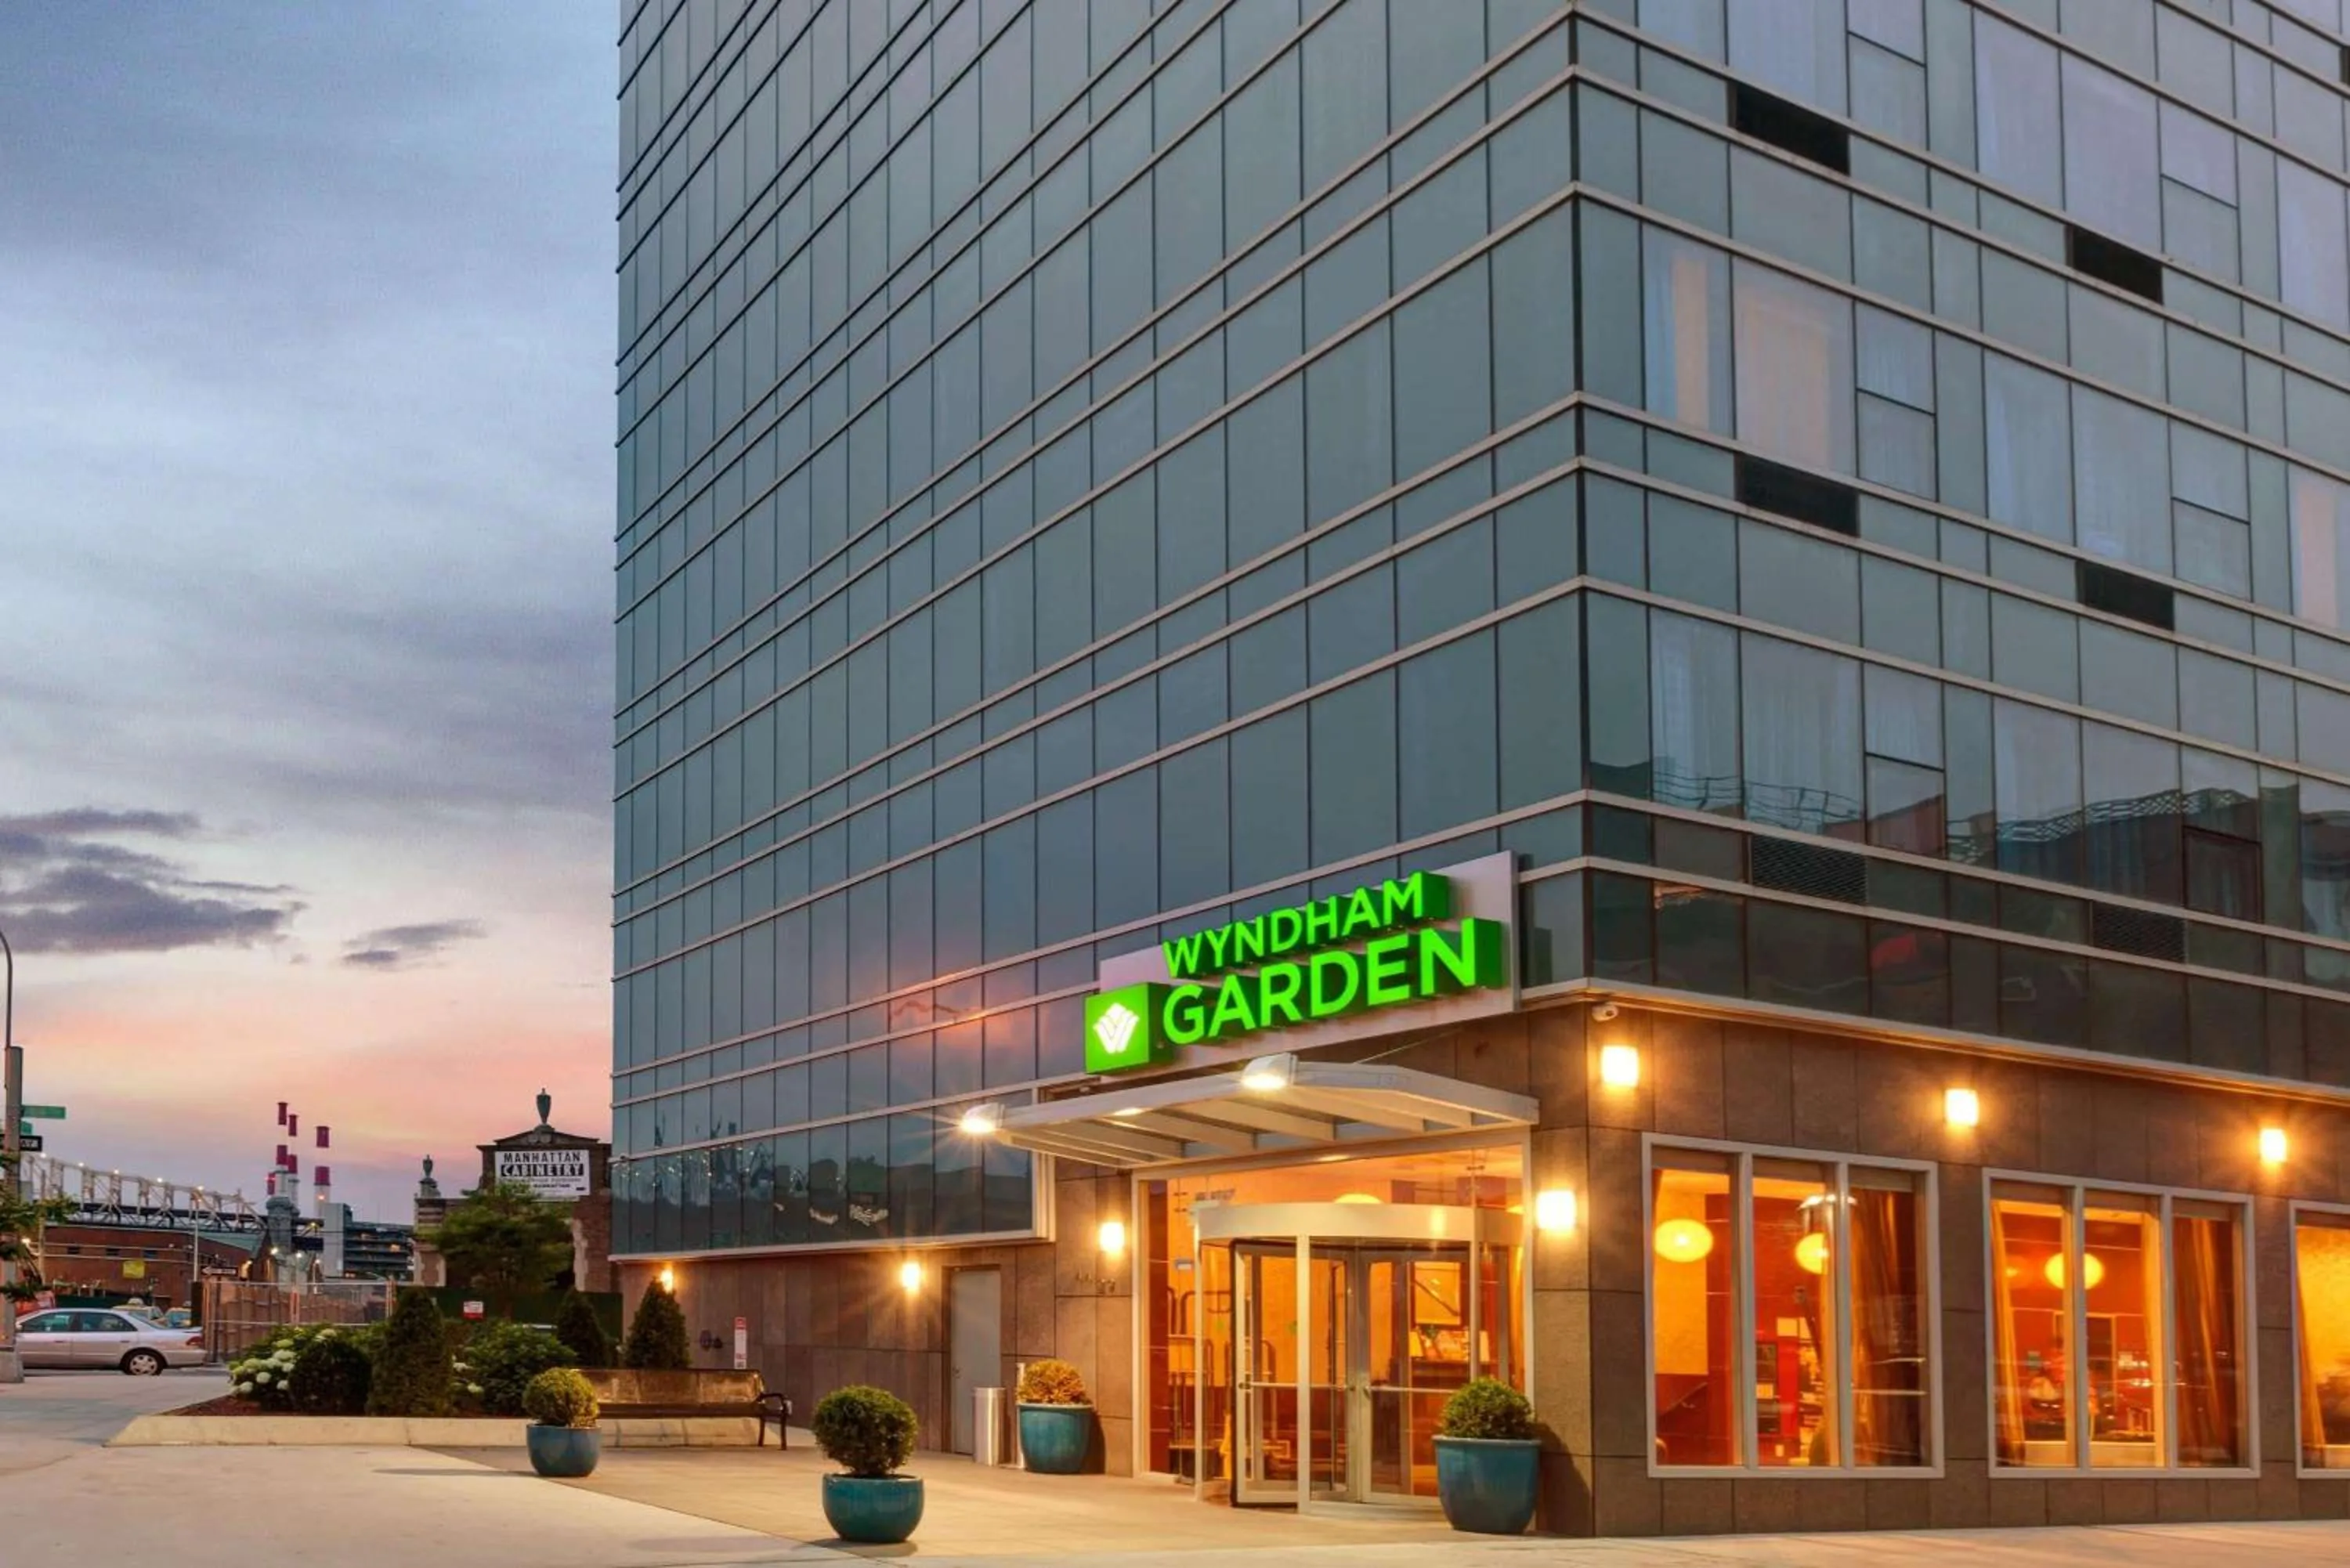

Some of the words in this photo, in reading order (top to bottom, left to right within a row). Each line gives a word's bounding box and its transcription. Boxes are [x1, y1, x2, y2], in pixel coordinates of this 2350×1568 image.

[1162, 870, 1424, 979] WYNDHAM
[1162, 917, 1477, 1045] GARDEN
[502, 1165, 583, 1176] CABINETRY
[504, 1152, 580, 1163] MANHATTAN
